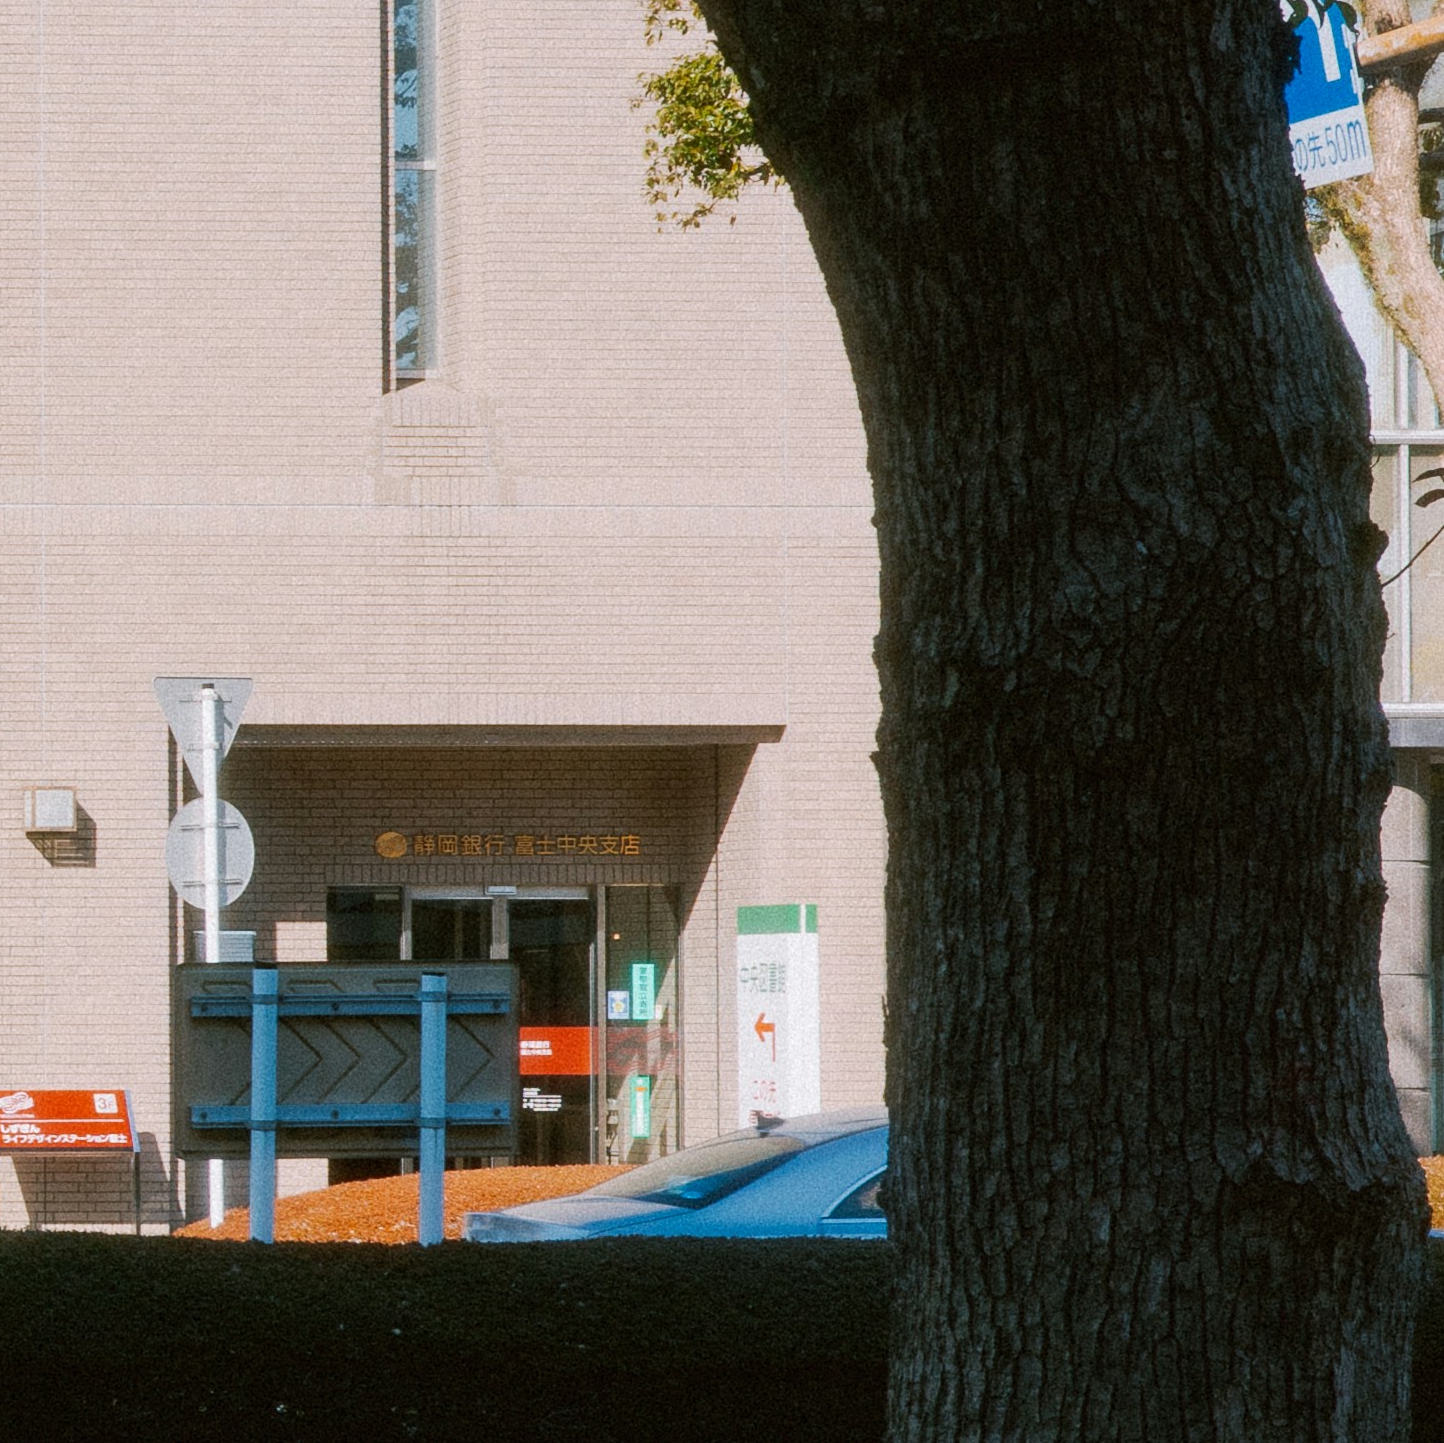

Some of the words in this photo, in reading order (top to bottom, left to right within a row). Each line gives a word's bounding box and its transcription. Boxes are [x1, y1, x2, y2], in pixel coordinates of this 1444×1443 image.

[414, 835, 506, 856] 静岡銀行
[515, 835, 641, 856] 富士中央支店
[740, 962, 786, 993] 中央図書館
